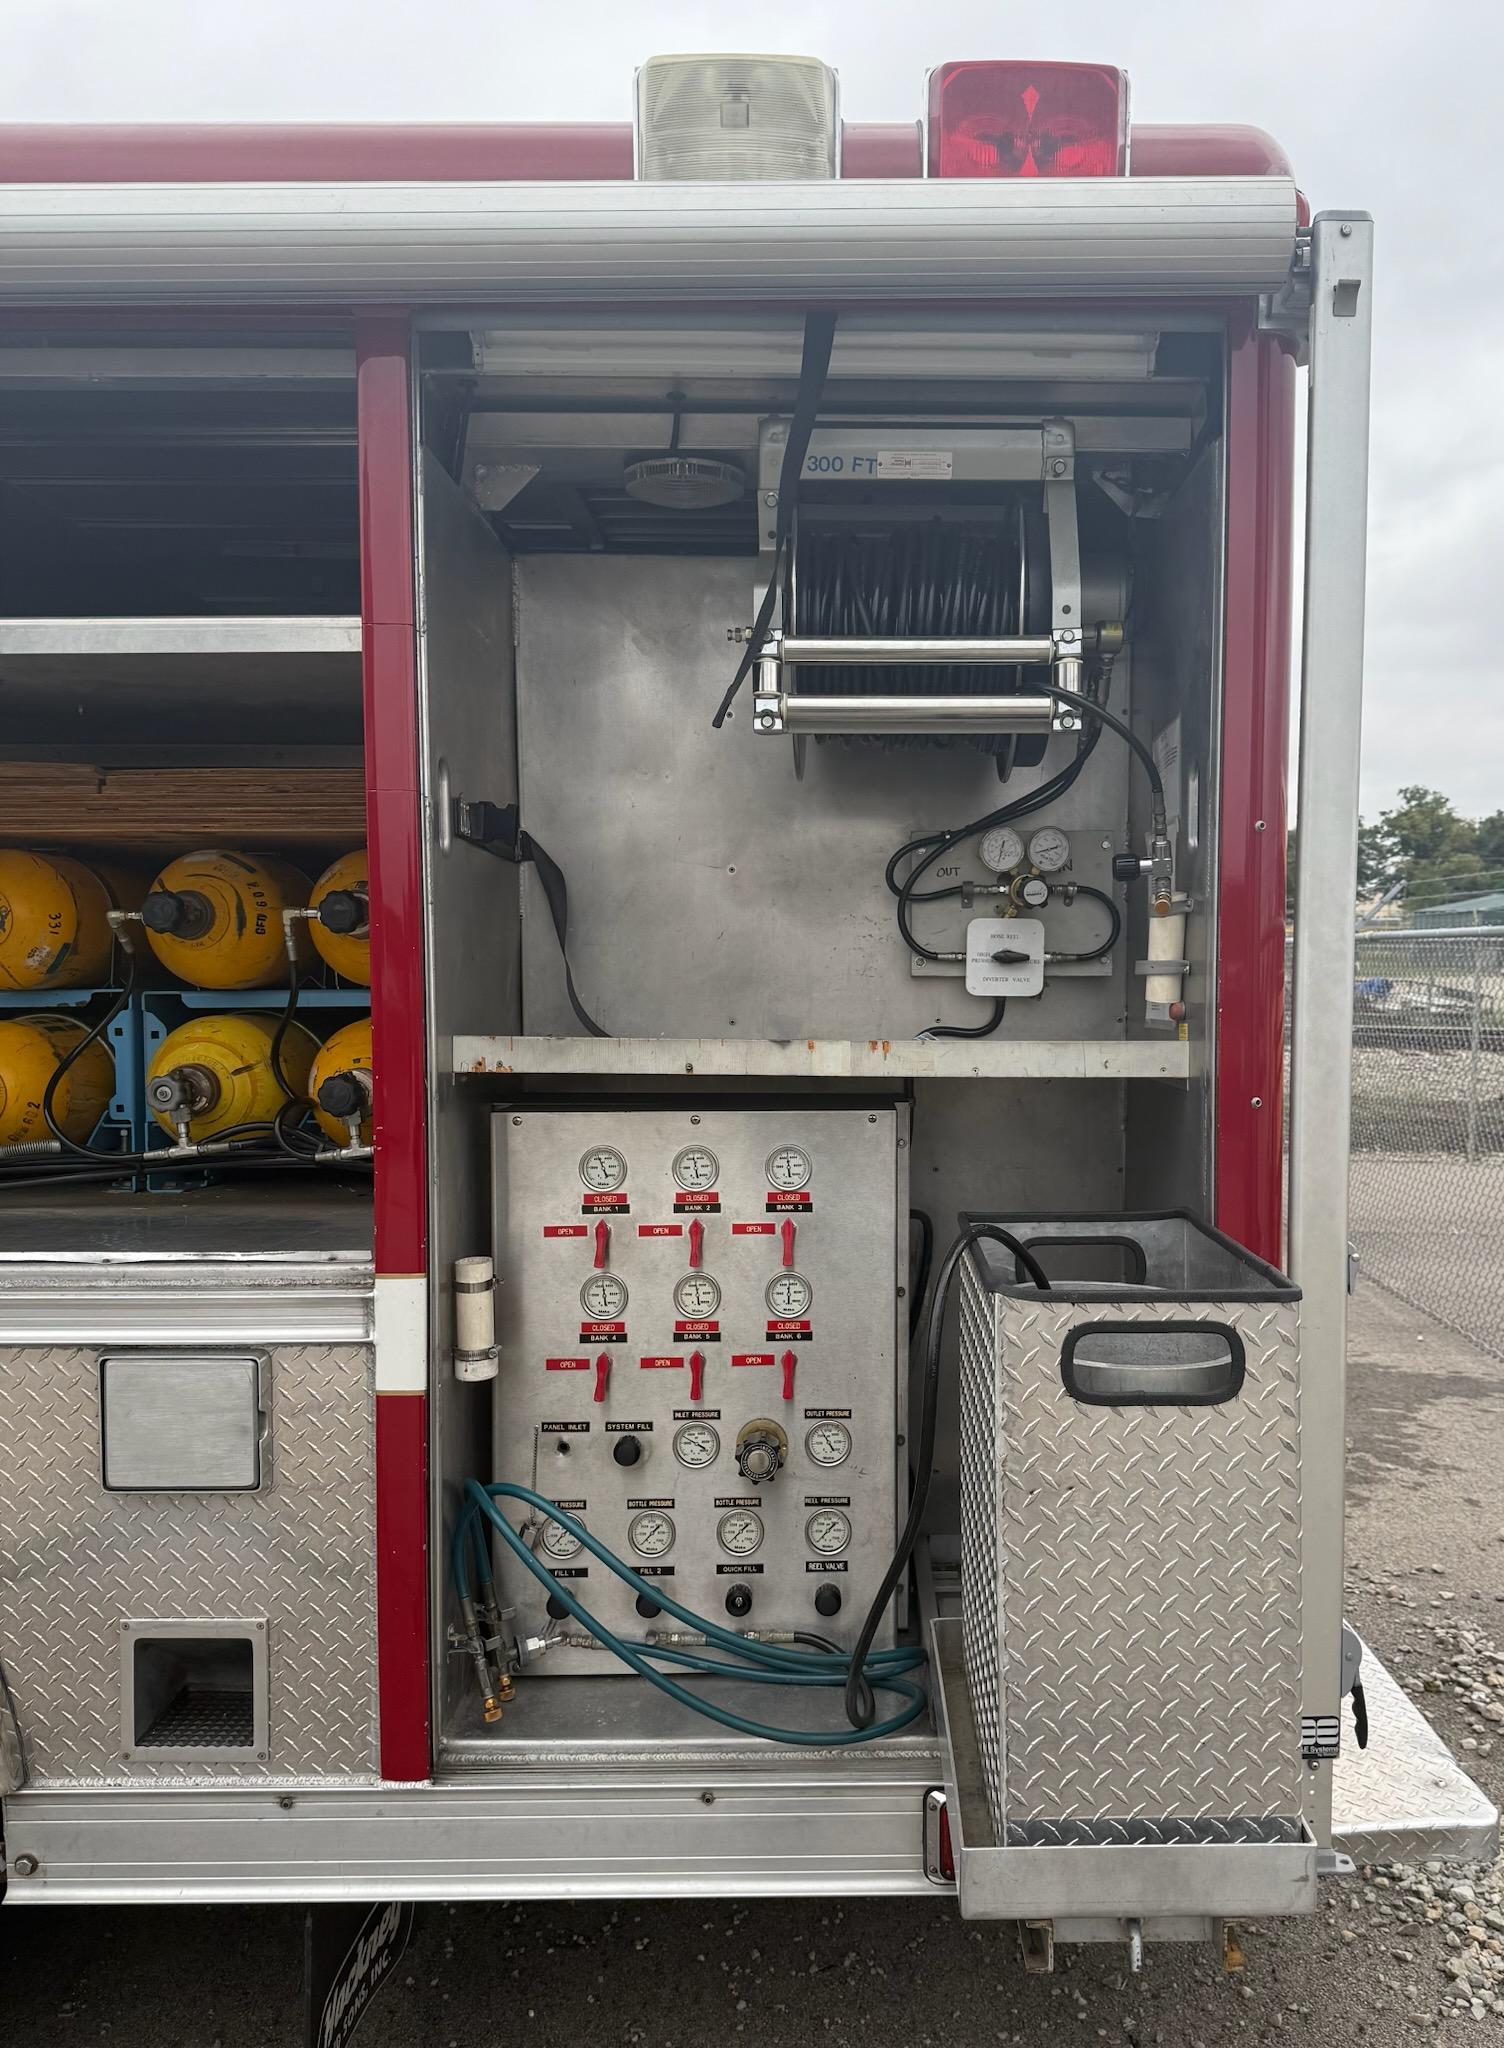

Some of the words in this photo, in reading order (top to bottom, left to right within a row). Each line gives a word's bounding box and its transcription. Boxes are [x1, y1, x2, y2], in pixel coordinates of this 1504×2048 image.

[807, 456, 844, 472] 300
[852, 457, 878, 474] FT
[936, 866, 961, 878] OUT
[593, 1195, 618, 1203] CLOSED
[685, 1194, 709, 1202] CLOSED
[777, 1193, 801, 1201] CLOSED
[652, 1227, 670, 1235] OPEN
[746, 1225, 762, 1233] OPEN
[592, 1324, 616, 1332] CLOSED
[686, 1322, 710, 1330] CLOSED
[778, 1322, 801, 1330] CLOSED
[560, 1360, 576, 1368] OPEN
[654, 1359, 670, 1367] OPEN
[746, 1356, 762, 1364] OPEN
